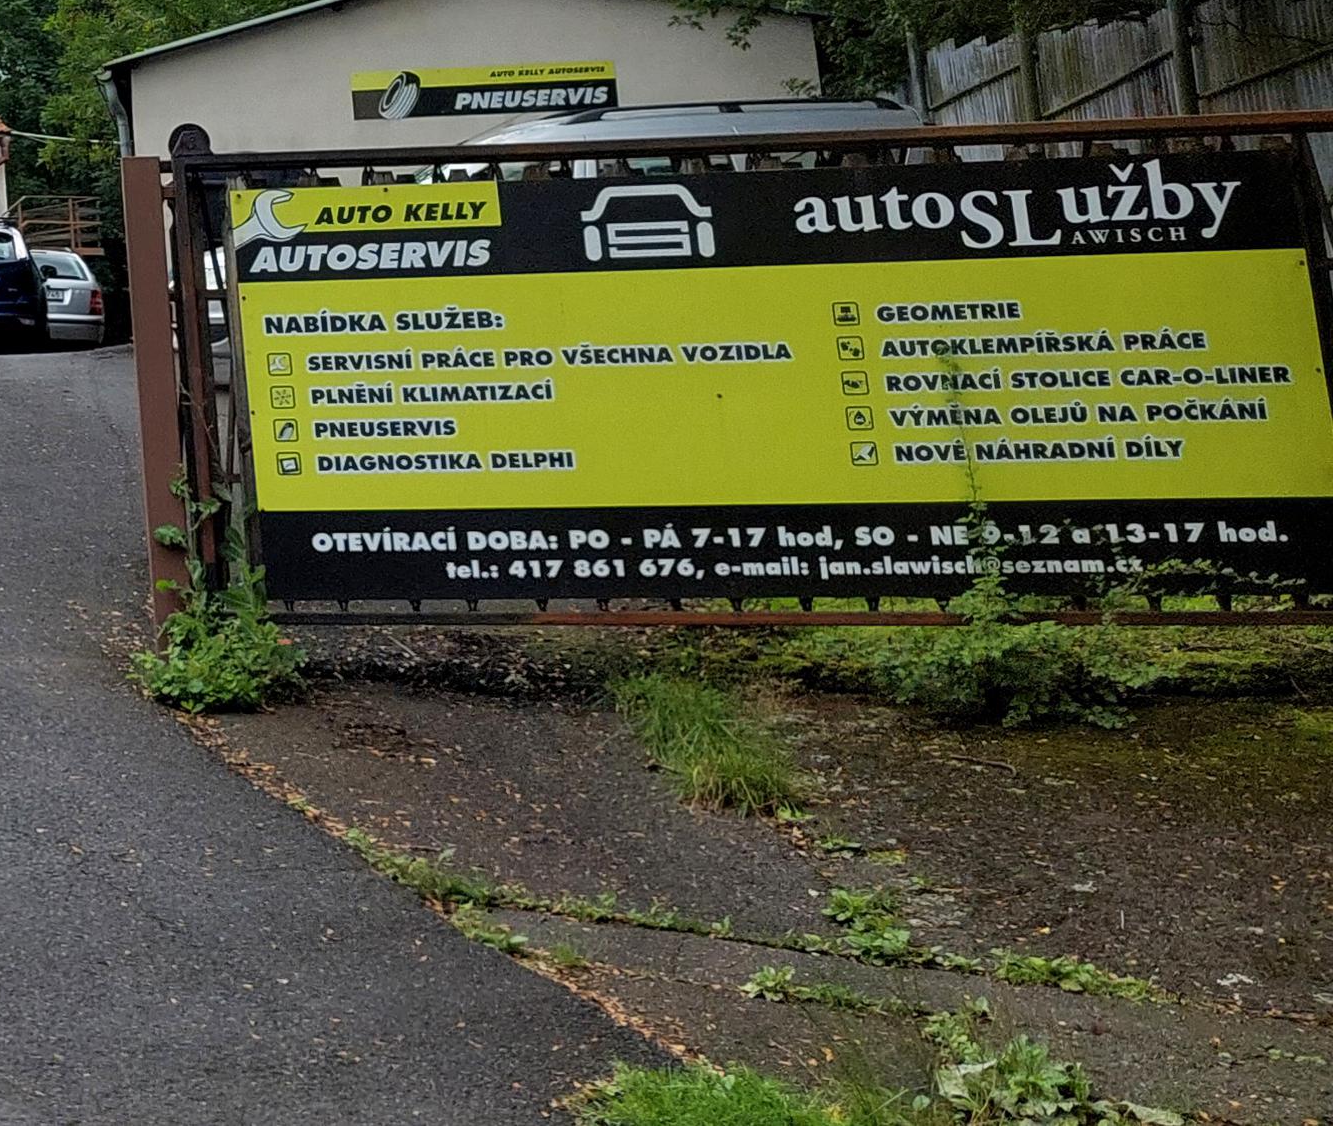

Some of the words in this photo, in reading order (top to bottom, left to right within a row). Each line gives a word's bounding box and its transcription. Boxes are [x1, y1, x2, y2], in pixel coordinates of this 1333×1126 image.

[490, 70, 515, 79] AUTO
[518, 68, 545, 77] KELLY
[548, 65, 606, 75] AUTOSERVIS
[454, 86, 609, 111] PNEUSERVIS
[314, 205, 393, 225] AUTO
[403, 201, 488, 222] KELLY
[1071, 226, 1187, 246] AWISCH
[249, 238, 492, 274] AUTOSERVIS
[264, 311, 387, 334] NABÍDKA
[396, 307, 504, 331] SLUŽEB:
[876, 302, 1021, 322] GEOMETRIE
[881, 330, 1115, 357] AUTOKLEMPÍŘSKÁ
[1124, 328, 1206, 351] PRÁCE
[307, 349, 413, 371] SERVISNÍ
[421, 347, 495, 369] PRÁCE
[504, 349, 553, 367] PRO
[561, 344, 674, 365] VŠECHNA
[681, 343, 793, 363] VOZIDLA
[310, 382, 394, 404] PLNĚNÍ
[402, 379, 552, 403] KLIMATIZACÍ
[885, 368, 1002, 392] ROVNACÍ
[1011, 370, 1111, 389] STOLICE
[1120, 366, 1292, 386] CAR-O-LINER
[889, 404, 1003, 427] VÝMĚNA
[1011, 401, 1088, 425] OLEJŮ
[1098, 405, 1138, 422] NA
[1146, 398, 1267, 421] POČKÁNÍ
[314, 420, 456, 438] PNEUSERVIS
[895, 439, 967, 462] NOVÉ
[975, 437, 1116, 461] NÁHRADNÍ
[1125, 435, 1184, 458] DÍLY
[318, 453, 482, 472] DIAGNOSTIKA
[491, 451, 574, 469] DELPHI
[311, 526, 458, 553] OTEVÍRACÍ
[467, 530, 559, 552] DOBA:
[568, 529, 611, 550] PO
[621, 537, 633, 545] -
[643, 523, 682, 549] PÁ
[691, 527, 767, 549] 7-17
[777, 525, 844, 551] hod,
[855, 526, 895, 546] SO
[907, 534, 919, 542] -
[930, 525, 970, 546] NE
[982, 522, 1060, 545] 9-12
[1073, 527, 1091, 545] a
[1106, 522, 1205, 544] 13-17
[1218, 520, 1289, 543] hod.
[446, 559, 500, 579] tel.:
[508, 559, 564, 577] 417
[573, 559, 625, 577] 861
[638, 558, 705, 580] 676,
[714, 556, 809, 576] e-mail:
[819, 555, 1143, 580] jan.slawisch@seznam.cz
